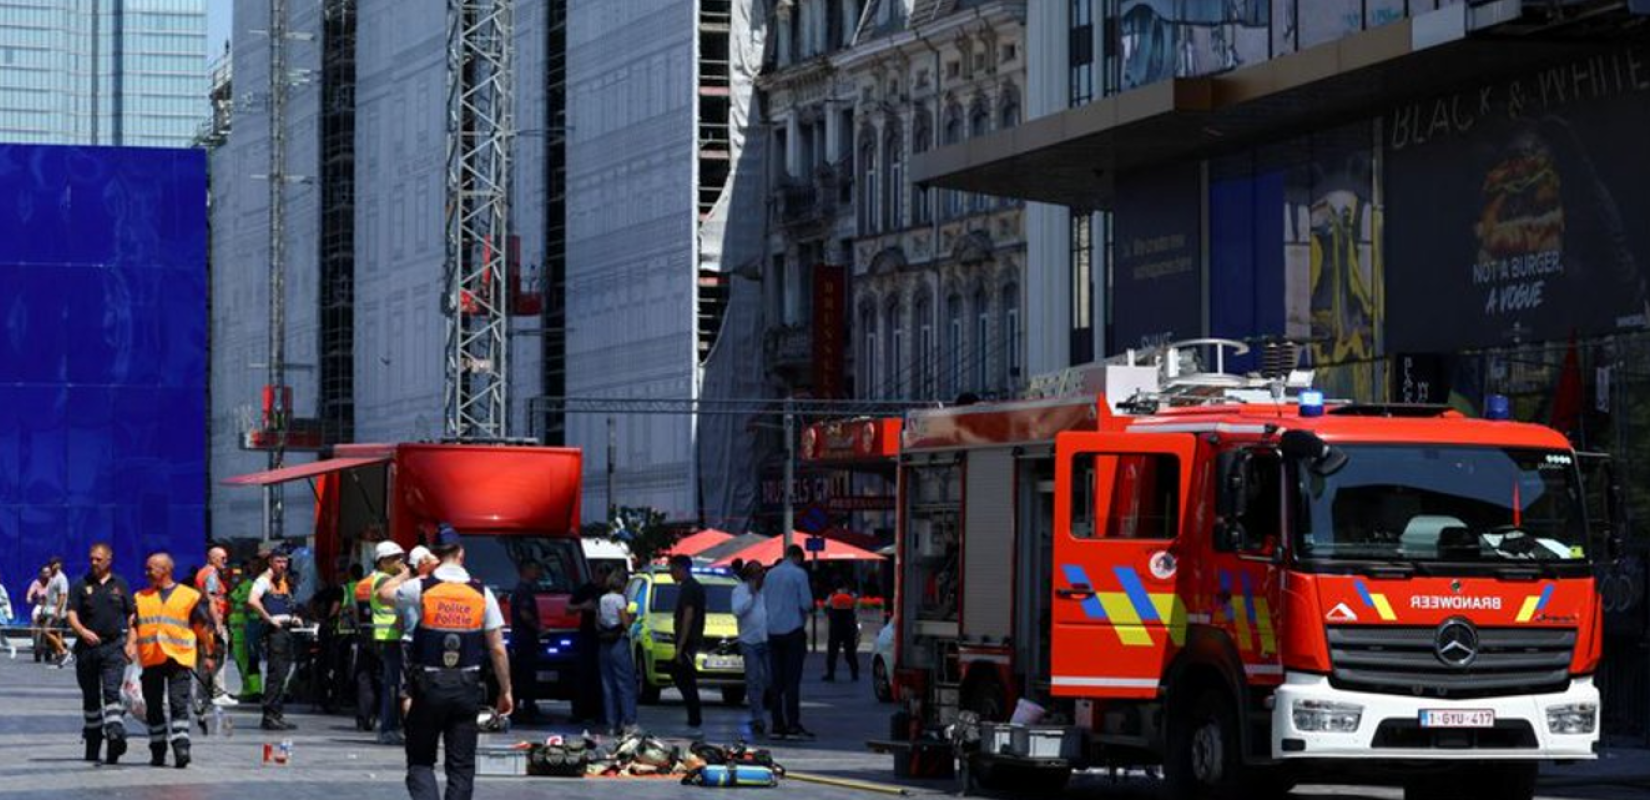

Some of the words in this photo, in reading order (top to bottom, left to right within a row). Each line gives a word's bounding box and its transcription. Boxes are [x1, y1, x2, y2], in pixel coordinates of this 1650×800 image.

[1391, 84, 1492, 149] BLACK
[1537, 46, 1650, 109] WHITE
[1473, 260, 1497, 284] NOT
[1499, 259, 1510, 280] A
[1485, 287, 1497, 316] A
[1500, 280, 1545, 313] VOGUE
[434, 613, 472, 625] Politie
[437, 600, 471, 614] Police
